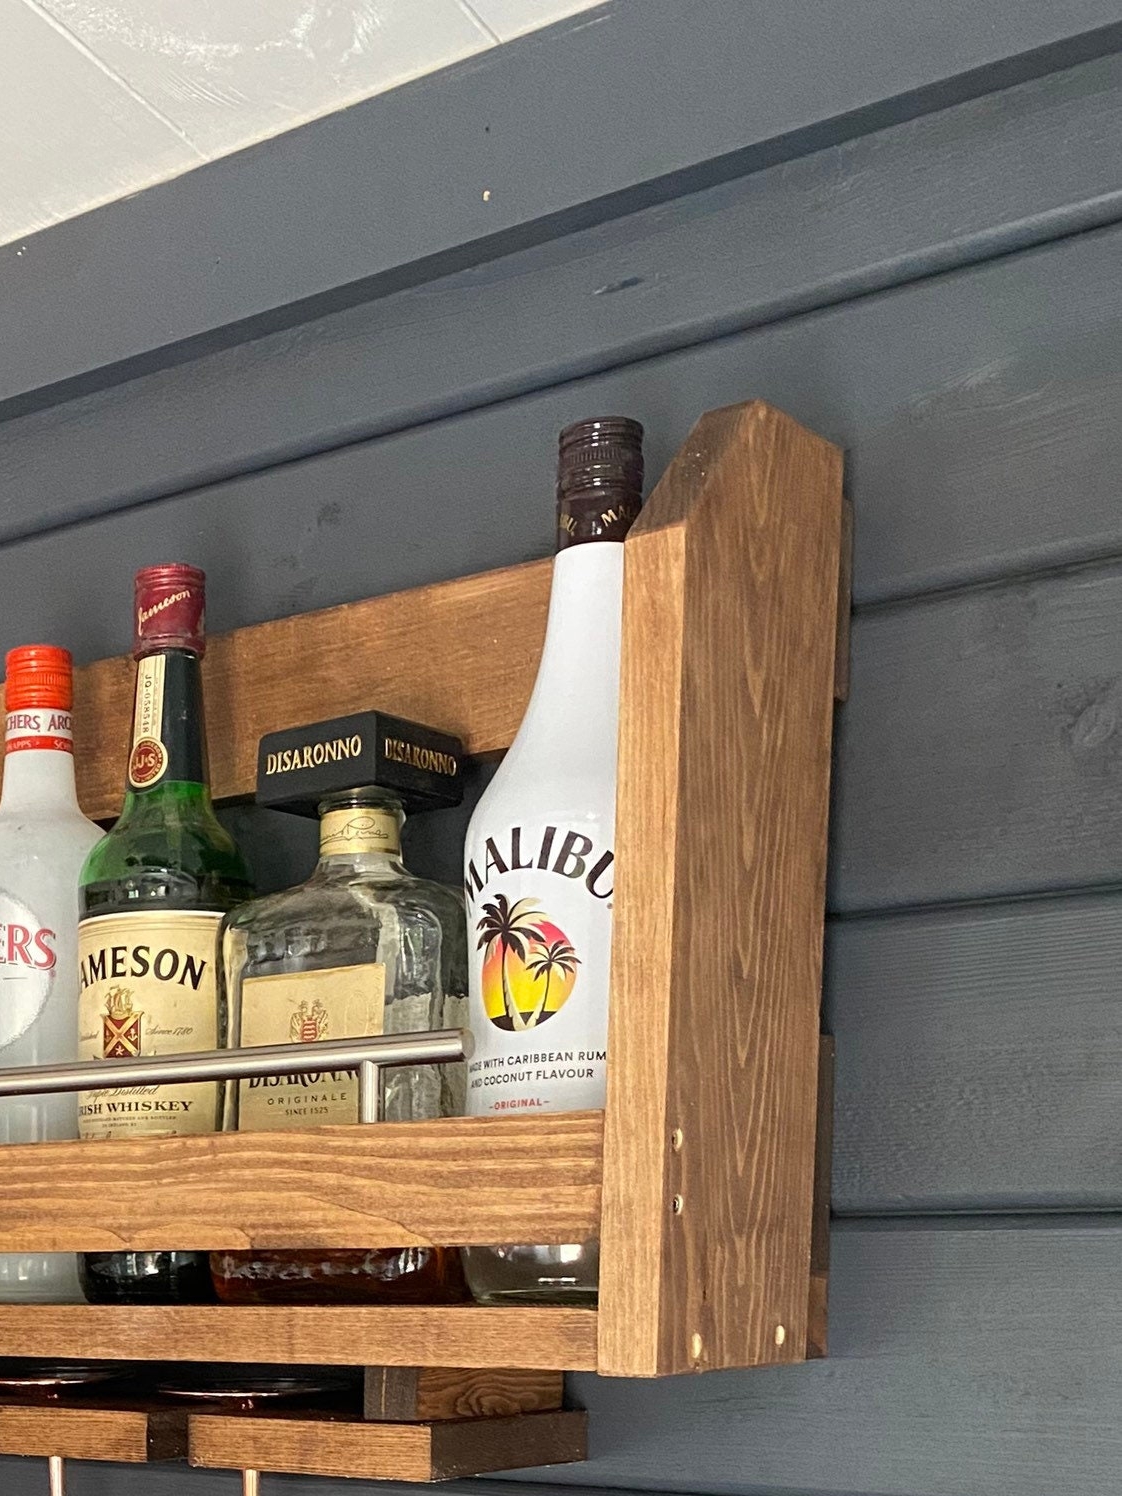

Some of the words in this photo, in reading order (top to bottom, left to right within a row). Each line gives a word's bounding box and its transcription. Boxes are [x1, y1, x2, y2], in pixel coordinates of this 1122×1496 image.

[138, 589, 191, 636] Jameson
[266, 734, 362, 775] DISARONNO
[384, 738, 457, 777] DISARONNO
[465, 826, 615, 908] MALIBU
[483, 1057, 505, 1069] WITH
[507, 1052, 574, 1066] CARIBBEAN
[578, 1051, 607, 1061] RUM
[484, 1071, 533, 1087] COCONUT
[536, 1068, 595, 1080] FLAVOUR
[106, 1100, 193, 1113] WHISKEY
[267, 1092, 347, 1105] ORIGINALE
[285, 1107, 308, 1116] SINCE
